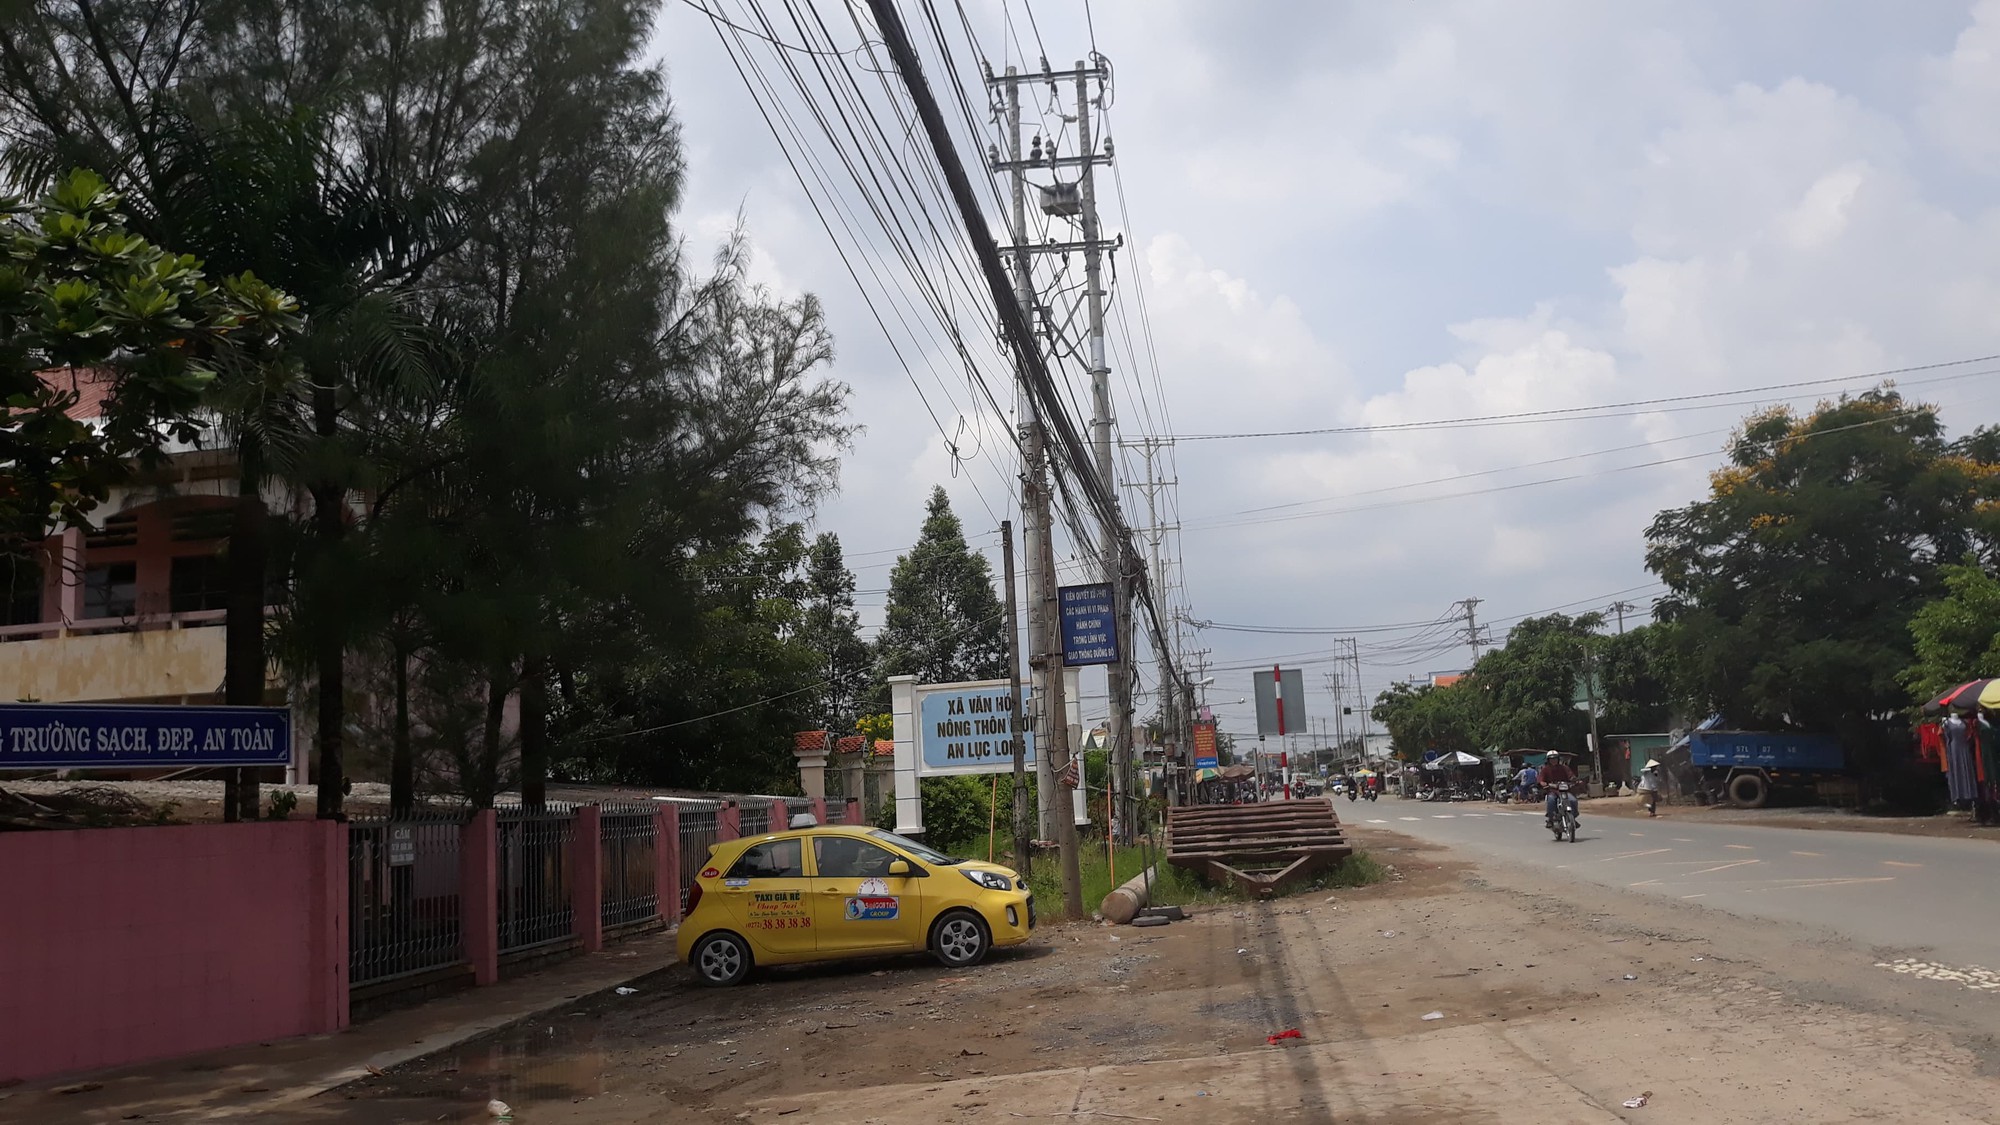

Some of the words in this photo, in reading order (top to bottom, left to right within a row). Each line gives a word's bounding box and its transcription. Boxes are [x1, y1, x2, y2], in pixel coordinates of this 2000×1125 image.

[1065, 605, 1075, 616] CÁC
[1073, 635, 1087, 645] TRONG
[1067, 651, 1079, 661] GIAO
[948, 696, 965, 716] XÃ
[968, 694, 992, 714] VĂN
[996, 692, 1012, 713] HÓ
[937, 718, 971, 738] NÔNG
[974, 715, 1007, 736] THÔN
[1010, 713, 1034, 734] ỚI
[10, 719, 91, 752] TRƯỜNG
[97, 726, 151, 757] SẠCH,
[158, 726, 198, 757] ĐẸP,
[203, 727, 227, 751] AN
[231, 721, 275, 751] TOÀN
[947, 742, 964, 760] AN
[968, 741, 991, 761] LỤC
[755, 893, 773, 902] TAXI
[774, 892, 788, 901] GIÁ
[762, 918, 773, 930] 38
[775, 918, 786, 930] 38
[788, 917, 798, 929] 38
[800, 916, 811, 928] 38
